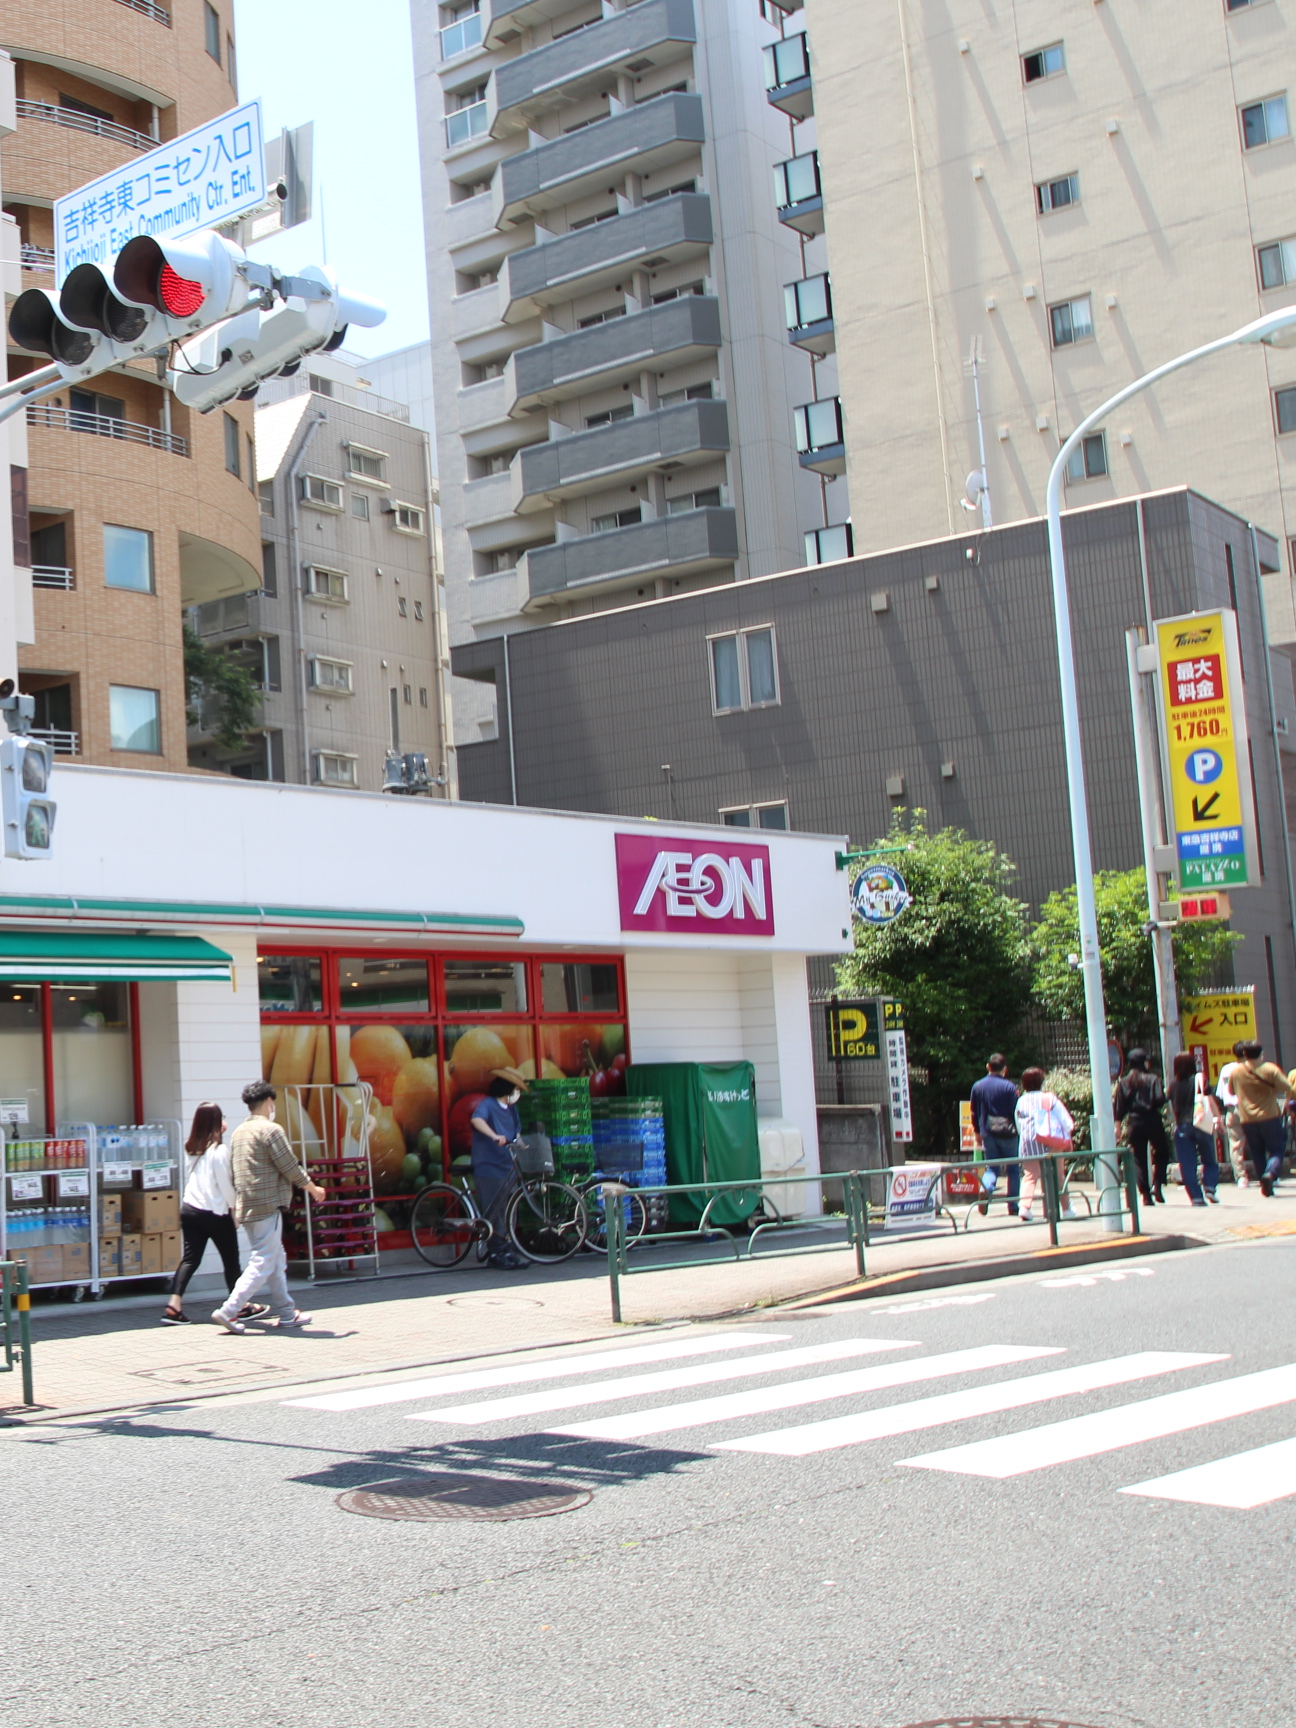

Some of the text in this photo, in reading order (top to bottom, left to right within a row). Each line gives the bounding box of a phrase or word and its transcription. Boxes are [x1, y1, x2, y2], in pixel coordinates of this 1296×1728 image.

[63, 121, 252, 243] 吉祥寺東コミセン入口
[110, 221, 134, 254] East
[138, 192, 201, 237] Community
[206, 180, 228, 210] Ctr.
[231, 165, 255, 199] Ent.
[1174, 628, 1212, 648] Times
[1176, 658, 1213, 682] 最大
[1177, 679, 1215, 702] 料金
[1193, 752, 1216, 781] P
[1219, 1012, 1248, 1027] 入口
[890, 1076, 902, 1119] 駐車場
